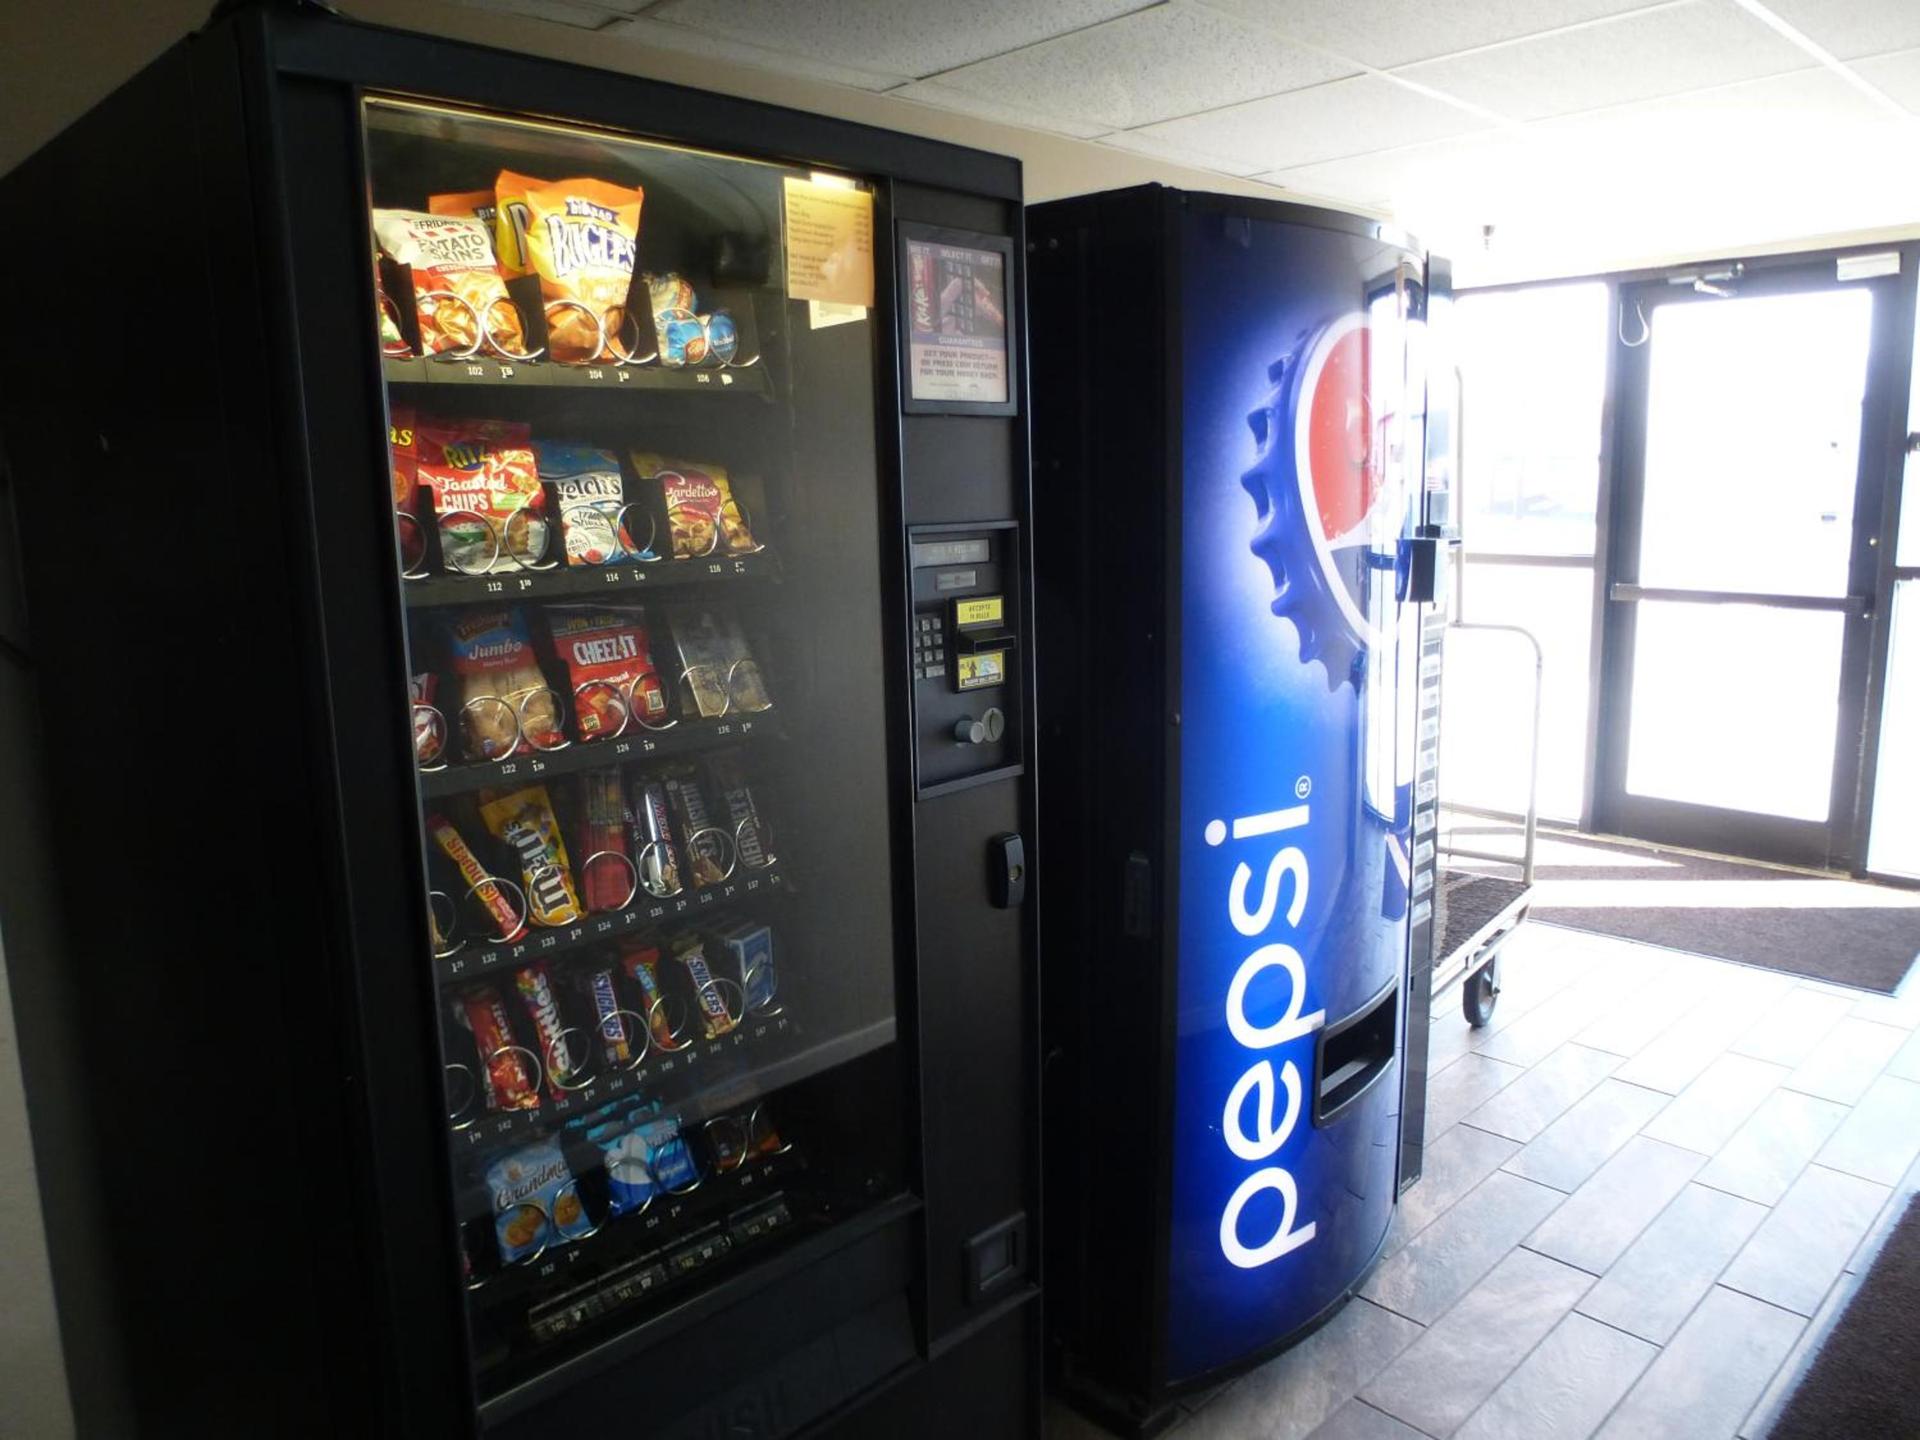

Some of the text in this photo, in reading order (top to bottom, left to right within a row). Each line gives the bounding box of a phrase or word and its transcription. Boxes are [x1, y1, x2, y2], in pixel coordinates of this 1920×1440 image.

[429, 247, 486, 263] SKINS
[467, 366, 484, 376] 102
[442, 492, 489, 511] CHIPS
[487, 581, 503, 592] 112
[468, 640, 523, 660] Jumbo
[1205, 804, 1325, 1268] pepsi
